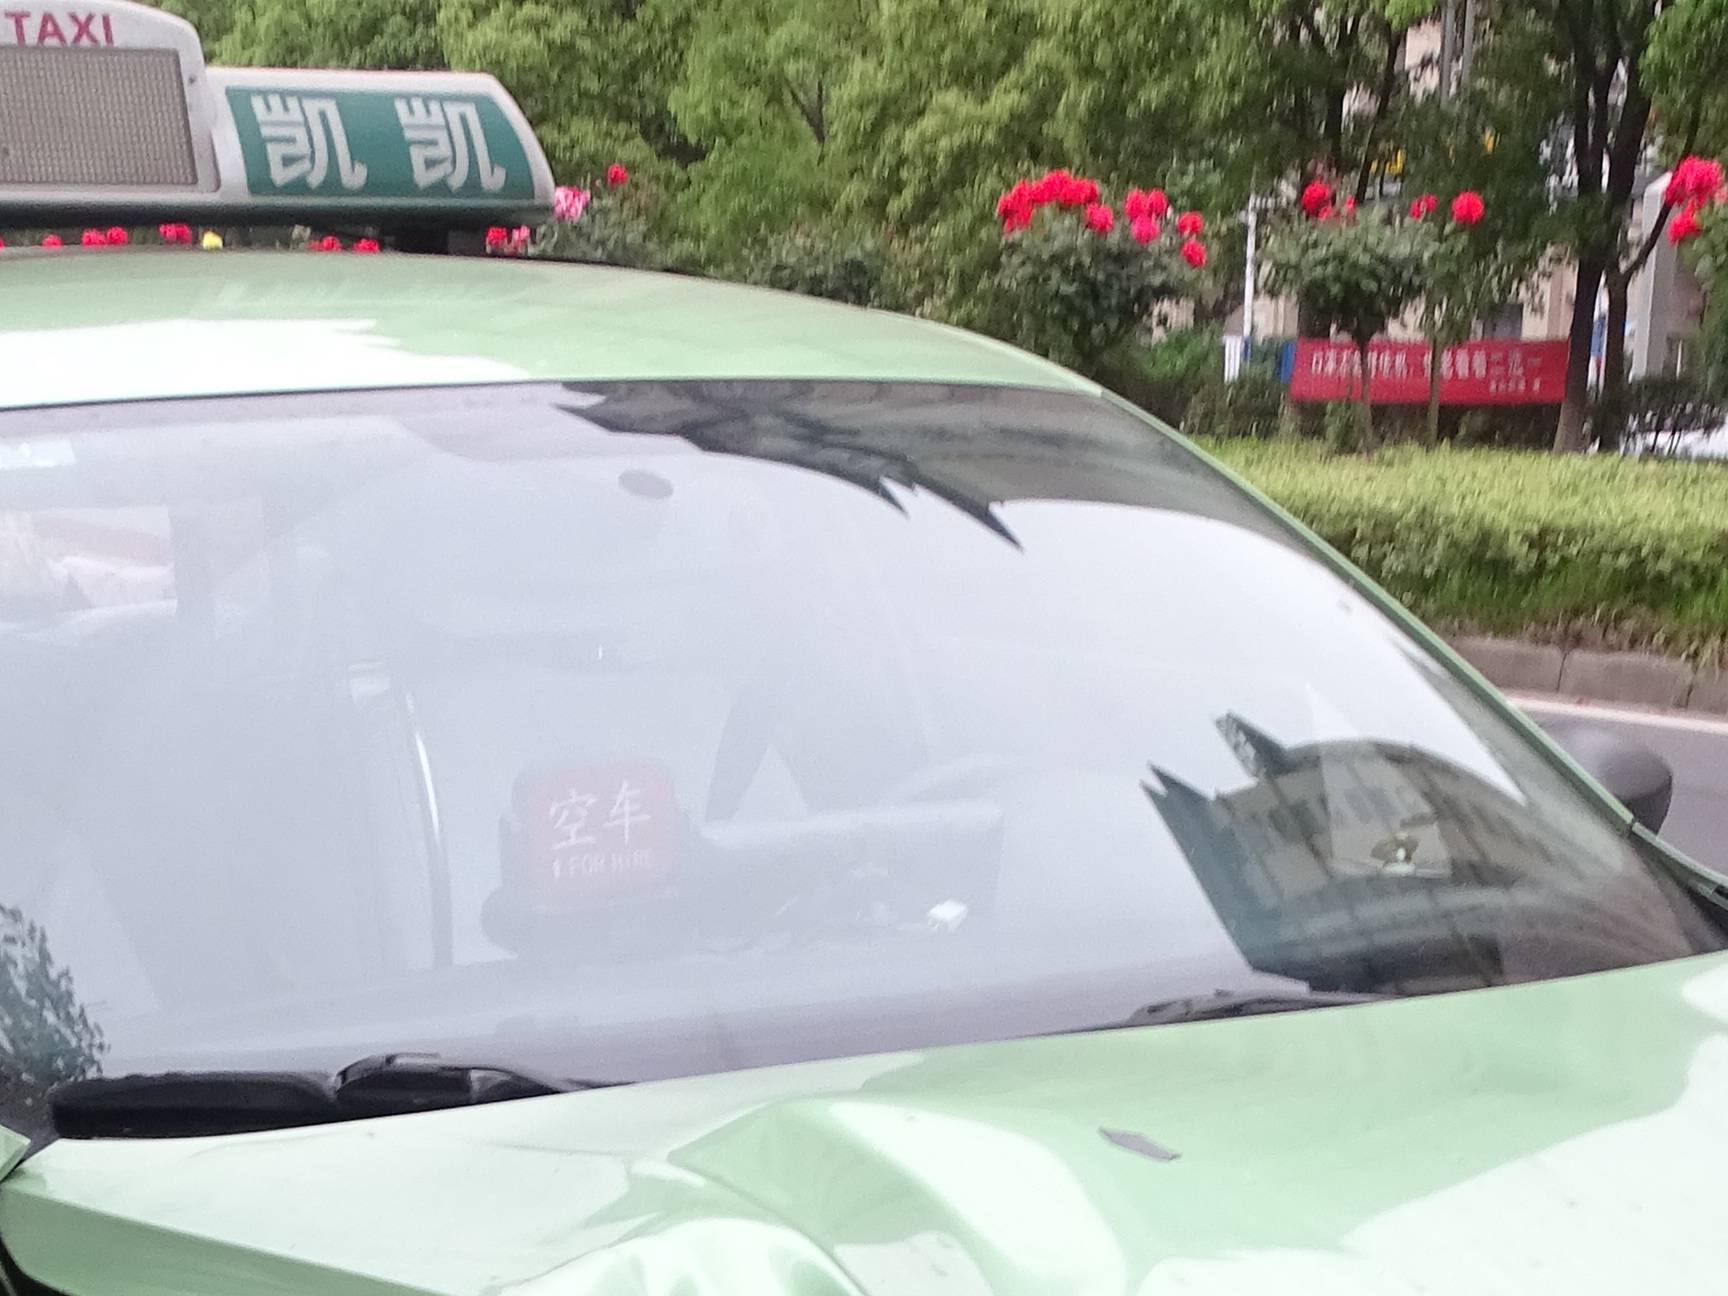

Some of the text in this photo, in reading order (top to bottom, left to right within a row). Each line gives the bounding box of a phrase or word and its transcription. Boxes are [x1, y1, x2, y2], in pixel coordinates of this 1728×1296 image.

[4, 10, 115, 48] TAXI
[251, 94, 507, 194] 凯凯
[547, 778, 652, 851] 空车
